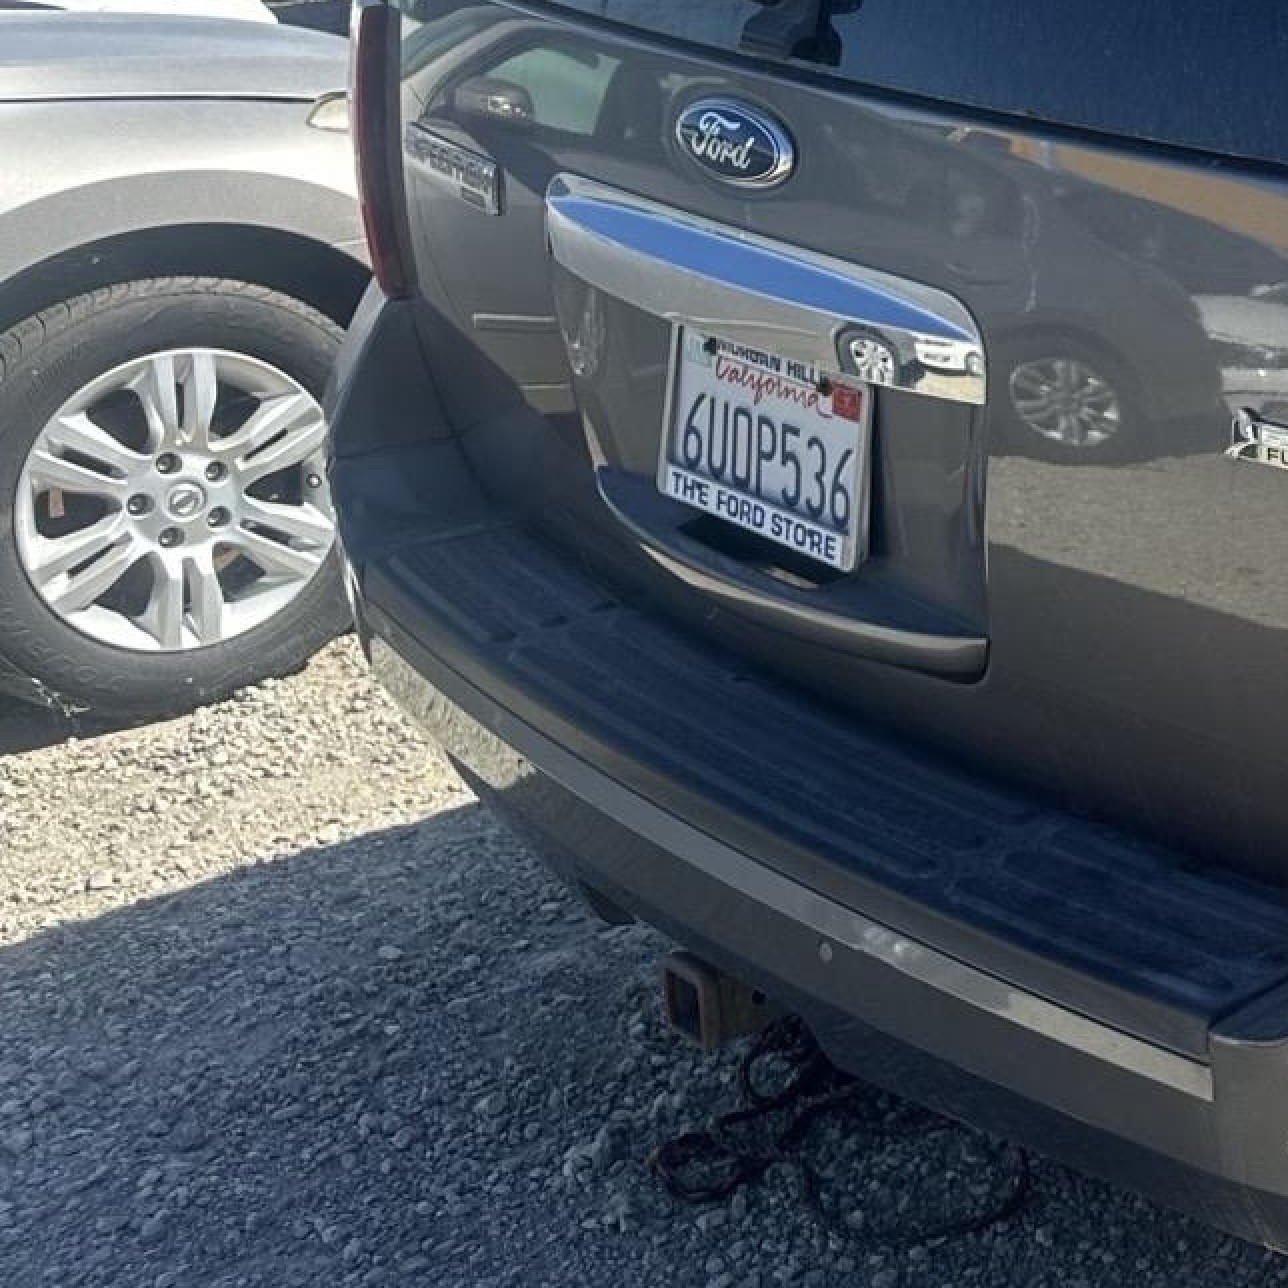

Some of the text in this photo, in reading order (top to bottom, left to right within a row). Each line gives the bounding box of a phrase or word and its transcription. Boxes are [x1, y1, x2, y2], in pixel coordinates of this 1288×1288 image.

[691, 111, 755, 169] Ford
[715, 355, 819, 408] California
[671, 471, 837, 561] THE FORD STORE
